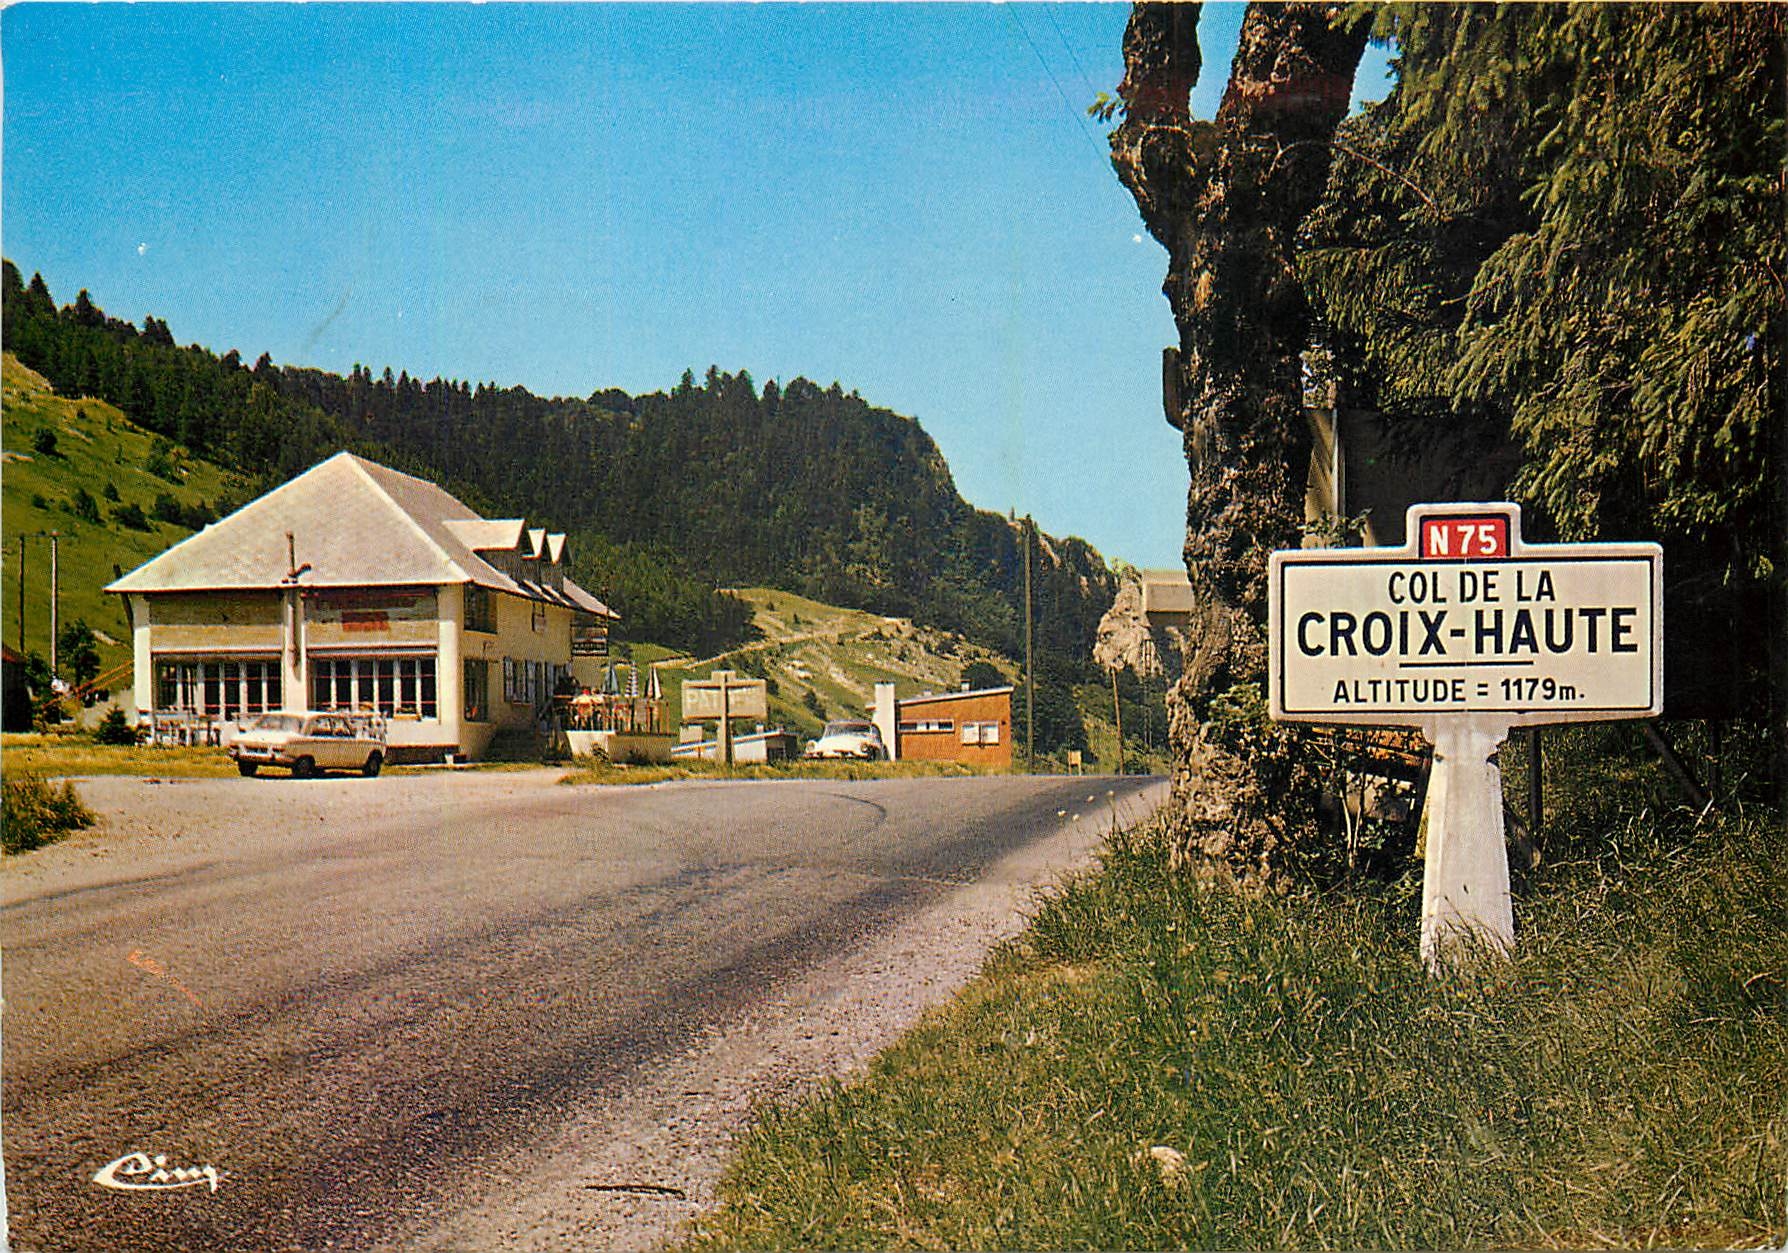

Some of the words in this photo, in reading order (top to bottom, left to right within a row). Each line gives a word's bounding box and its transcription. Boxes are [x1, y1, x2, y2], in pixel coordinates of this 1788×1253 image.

[1430, 525, 1449, 556] N
[1456, 524, 1498, 555] 75
[1388, 570, 1447, 605] COL
[1459, 570, 1500, 604] DE
[1516, 570, 1556, 602] LA
[1297, 607, 1639, 657] CROIX-HAUTE
[1333, 679, 1467, 704] ALTITUDE
[1476, 683, 1489, 697] =
